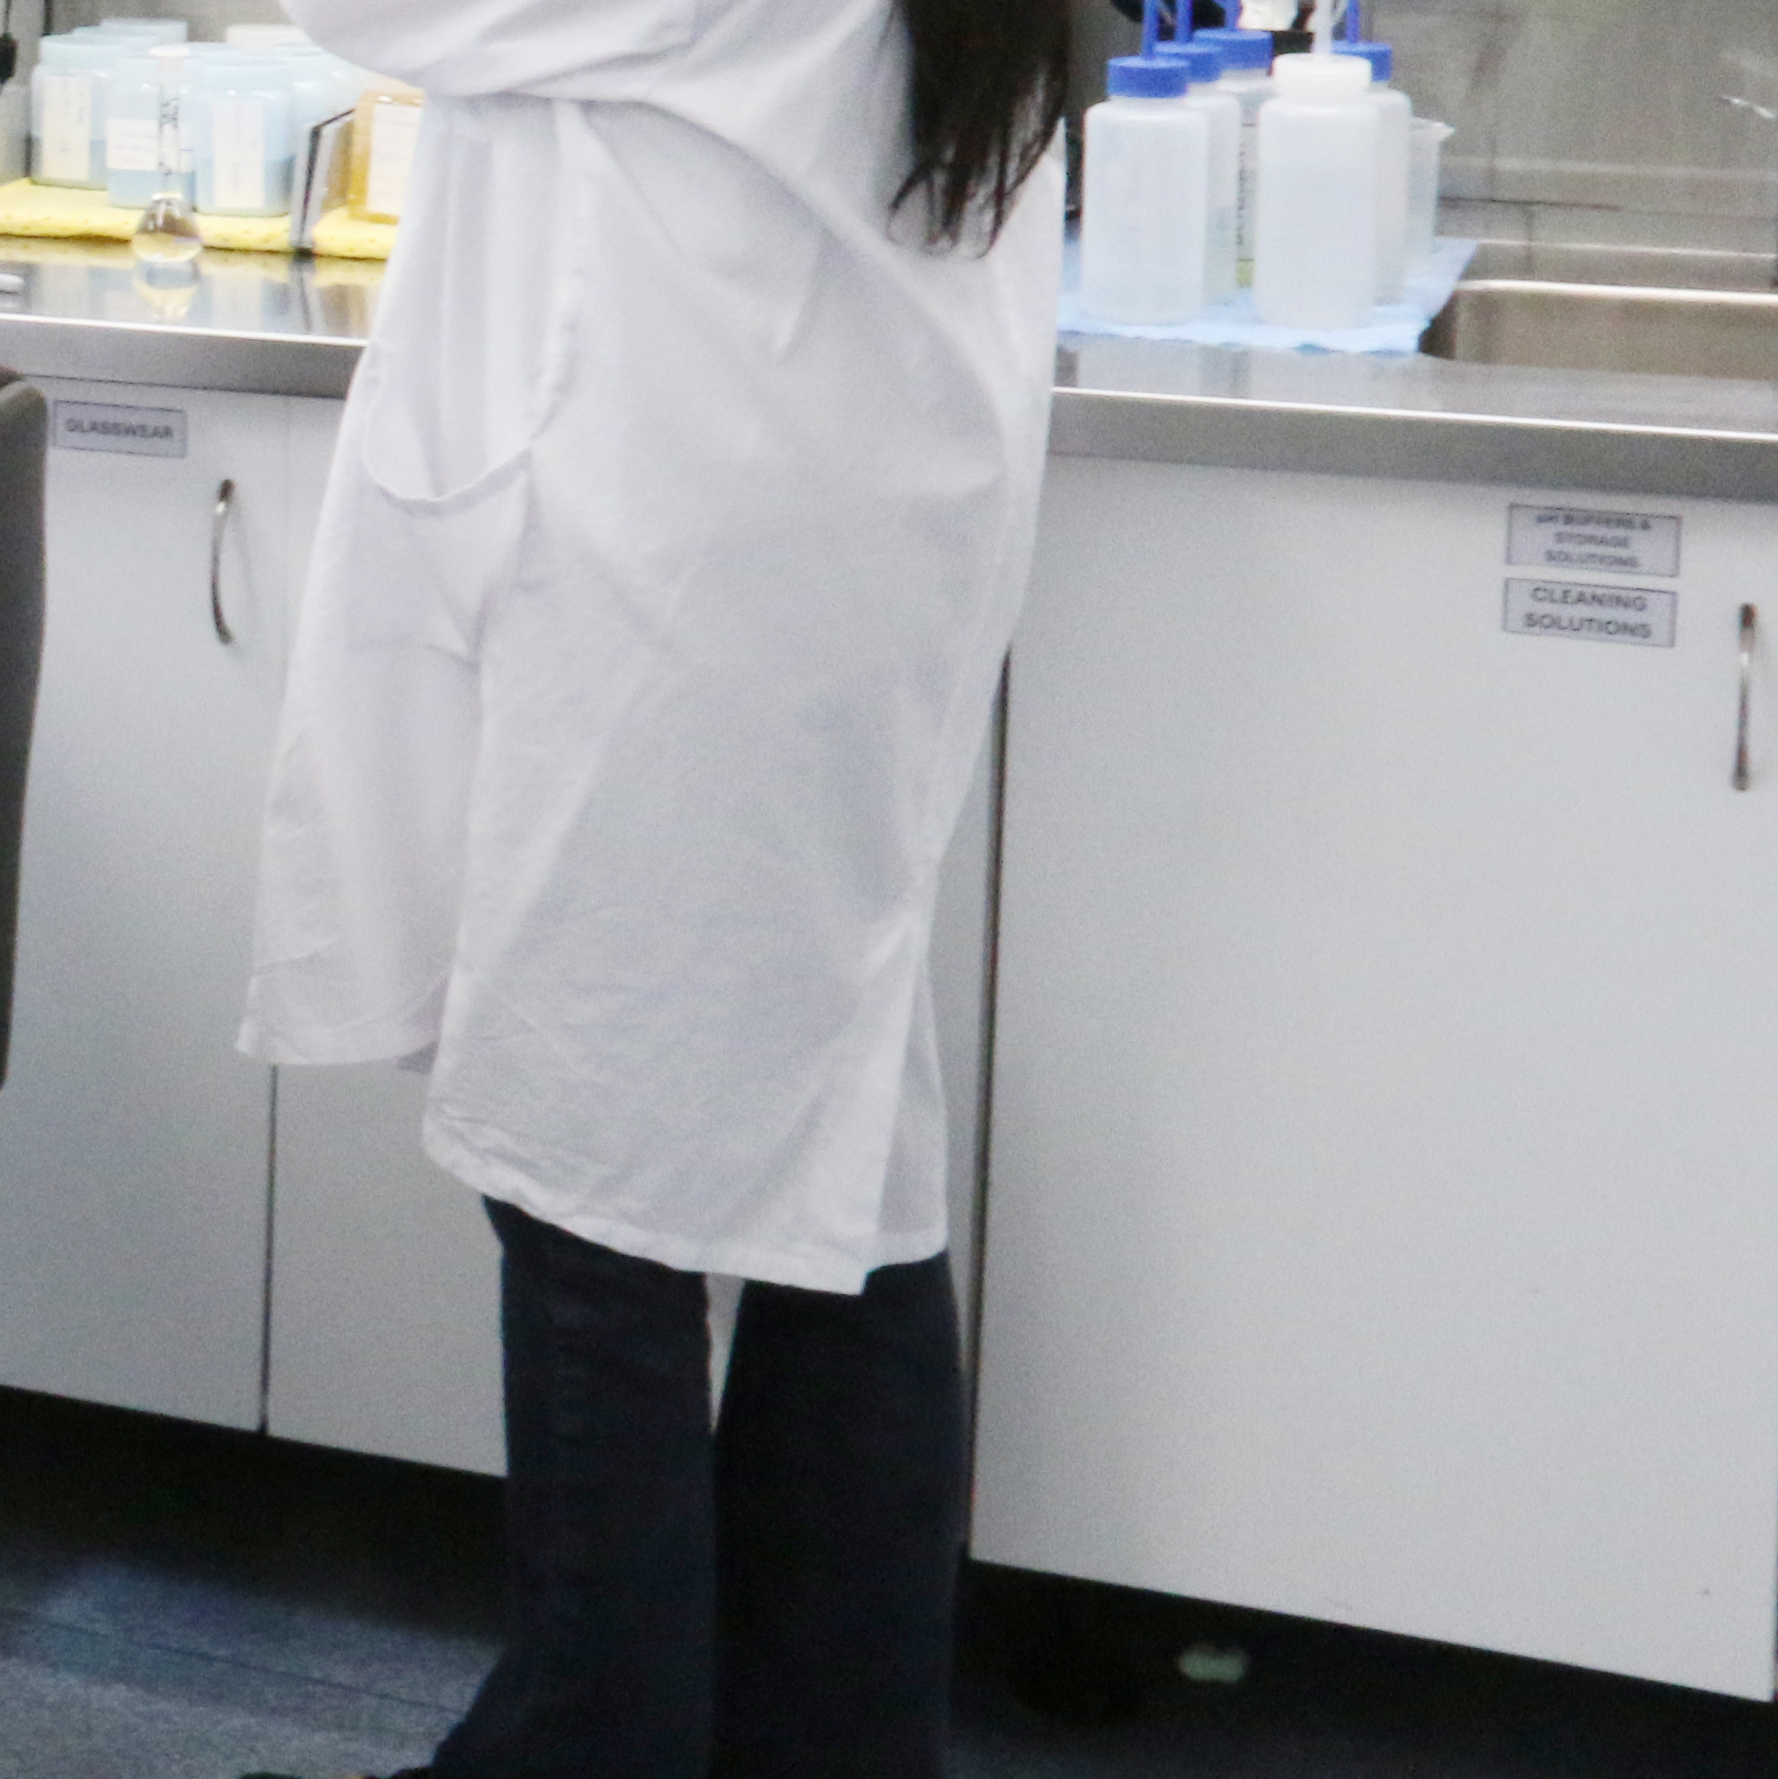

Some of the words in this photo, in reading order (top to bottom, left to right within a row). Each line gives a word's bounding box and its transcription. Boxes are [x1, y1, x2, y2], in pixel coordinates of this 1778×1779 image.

[1544, 548, 1640, 569] SOLUTIONS
[1530, 586, 1649, 612] CLEANING
[1523, 611, 1653, 640] SOLUTIONS
